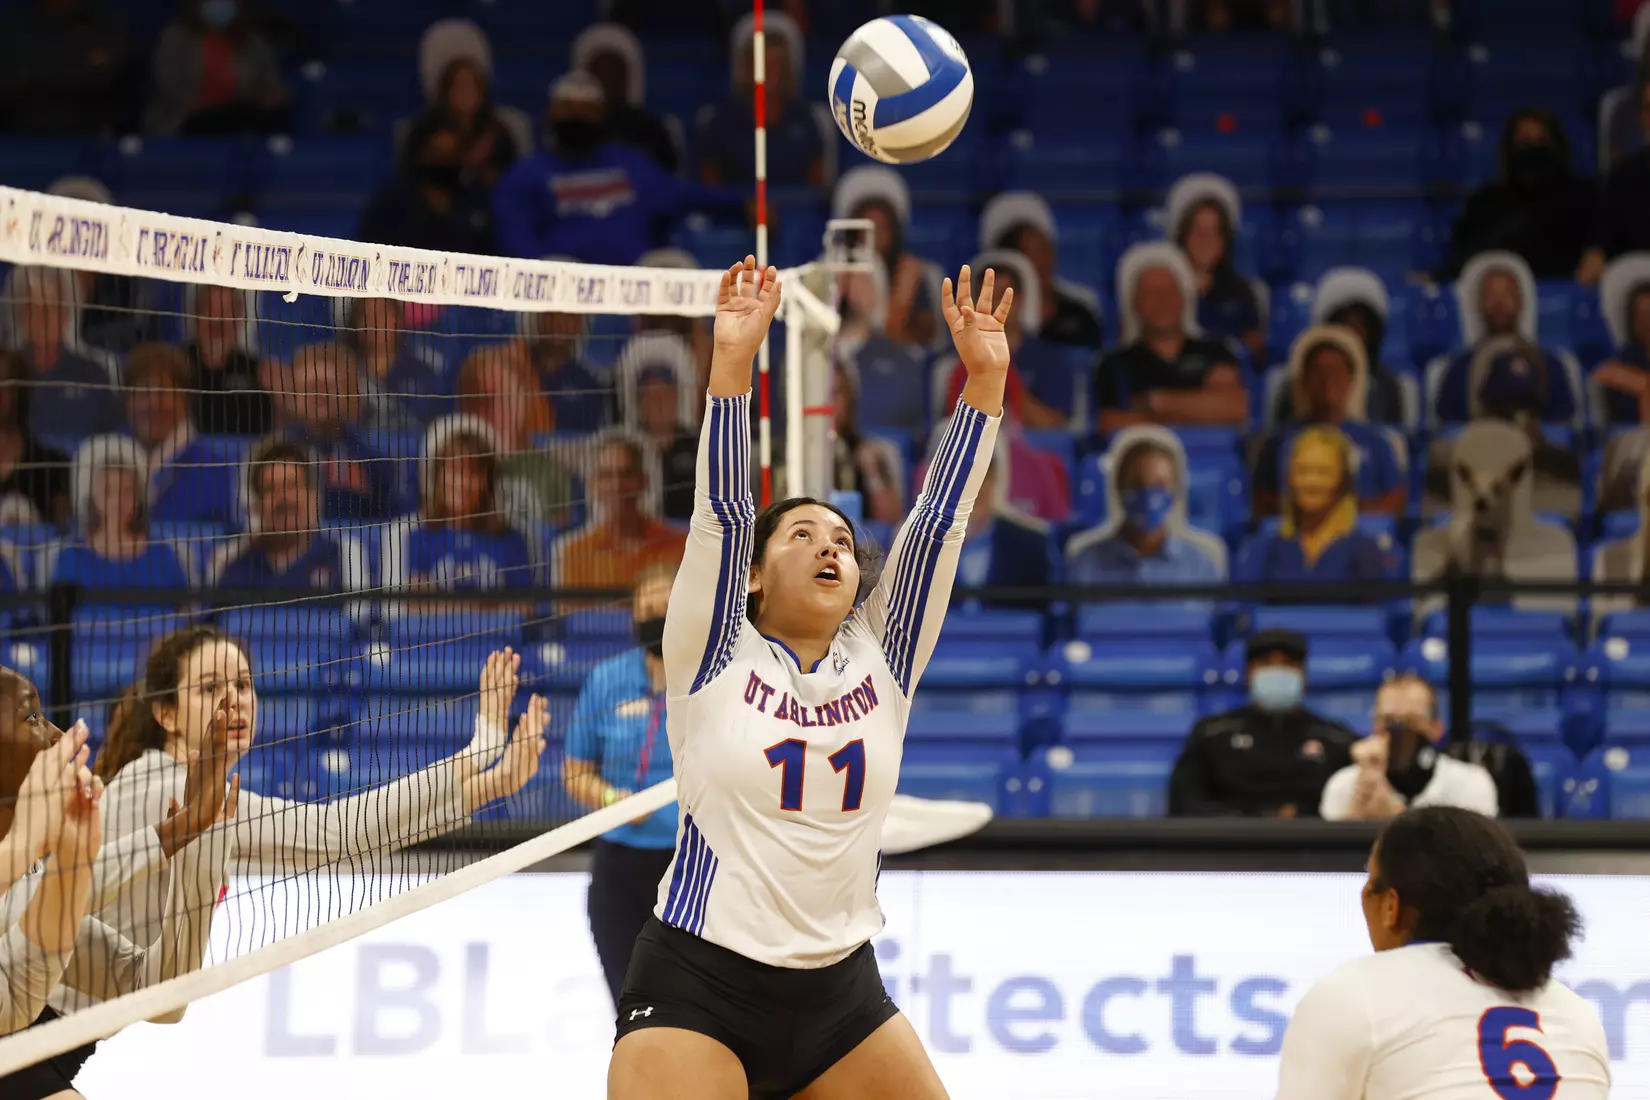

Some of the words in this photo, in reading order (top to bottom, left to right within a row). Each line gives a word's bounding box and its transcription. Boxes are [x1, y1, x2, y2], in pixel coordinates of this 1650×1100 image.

[744, 669, 775, 713] UT
[763, 737, 866, 812] 11
[1477, 1005, 1562, 1100] 6
